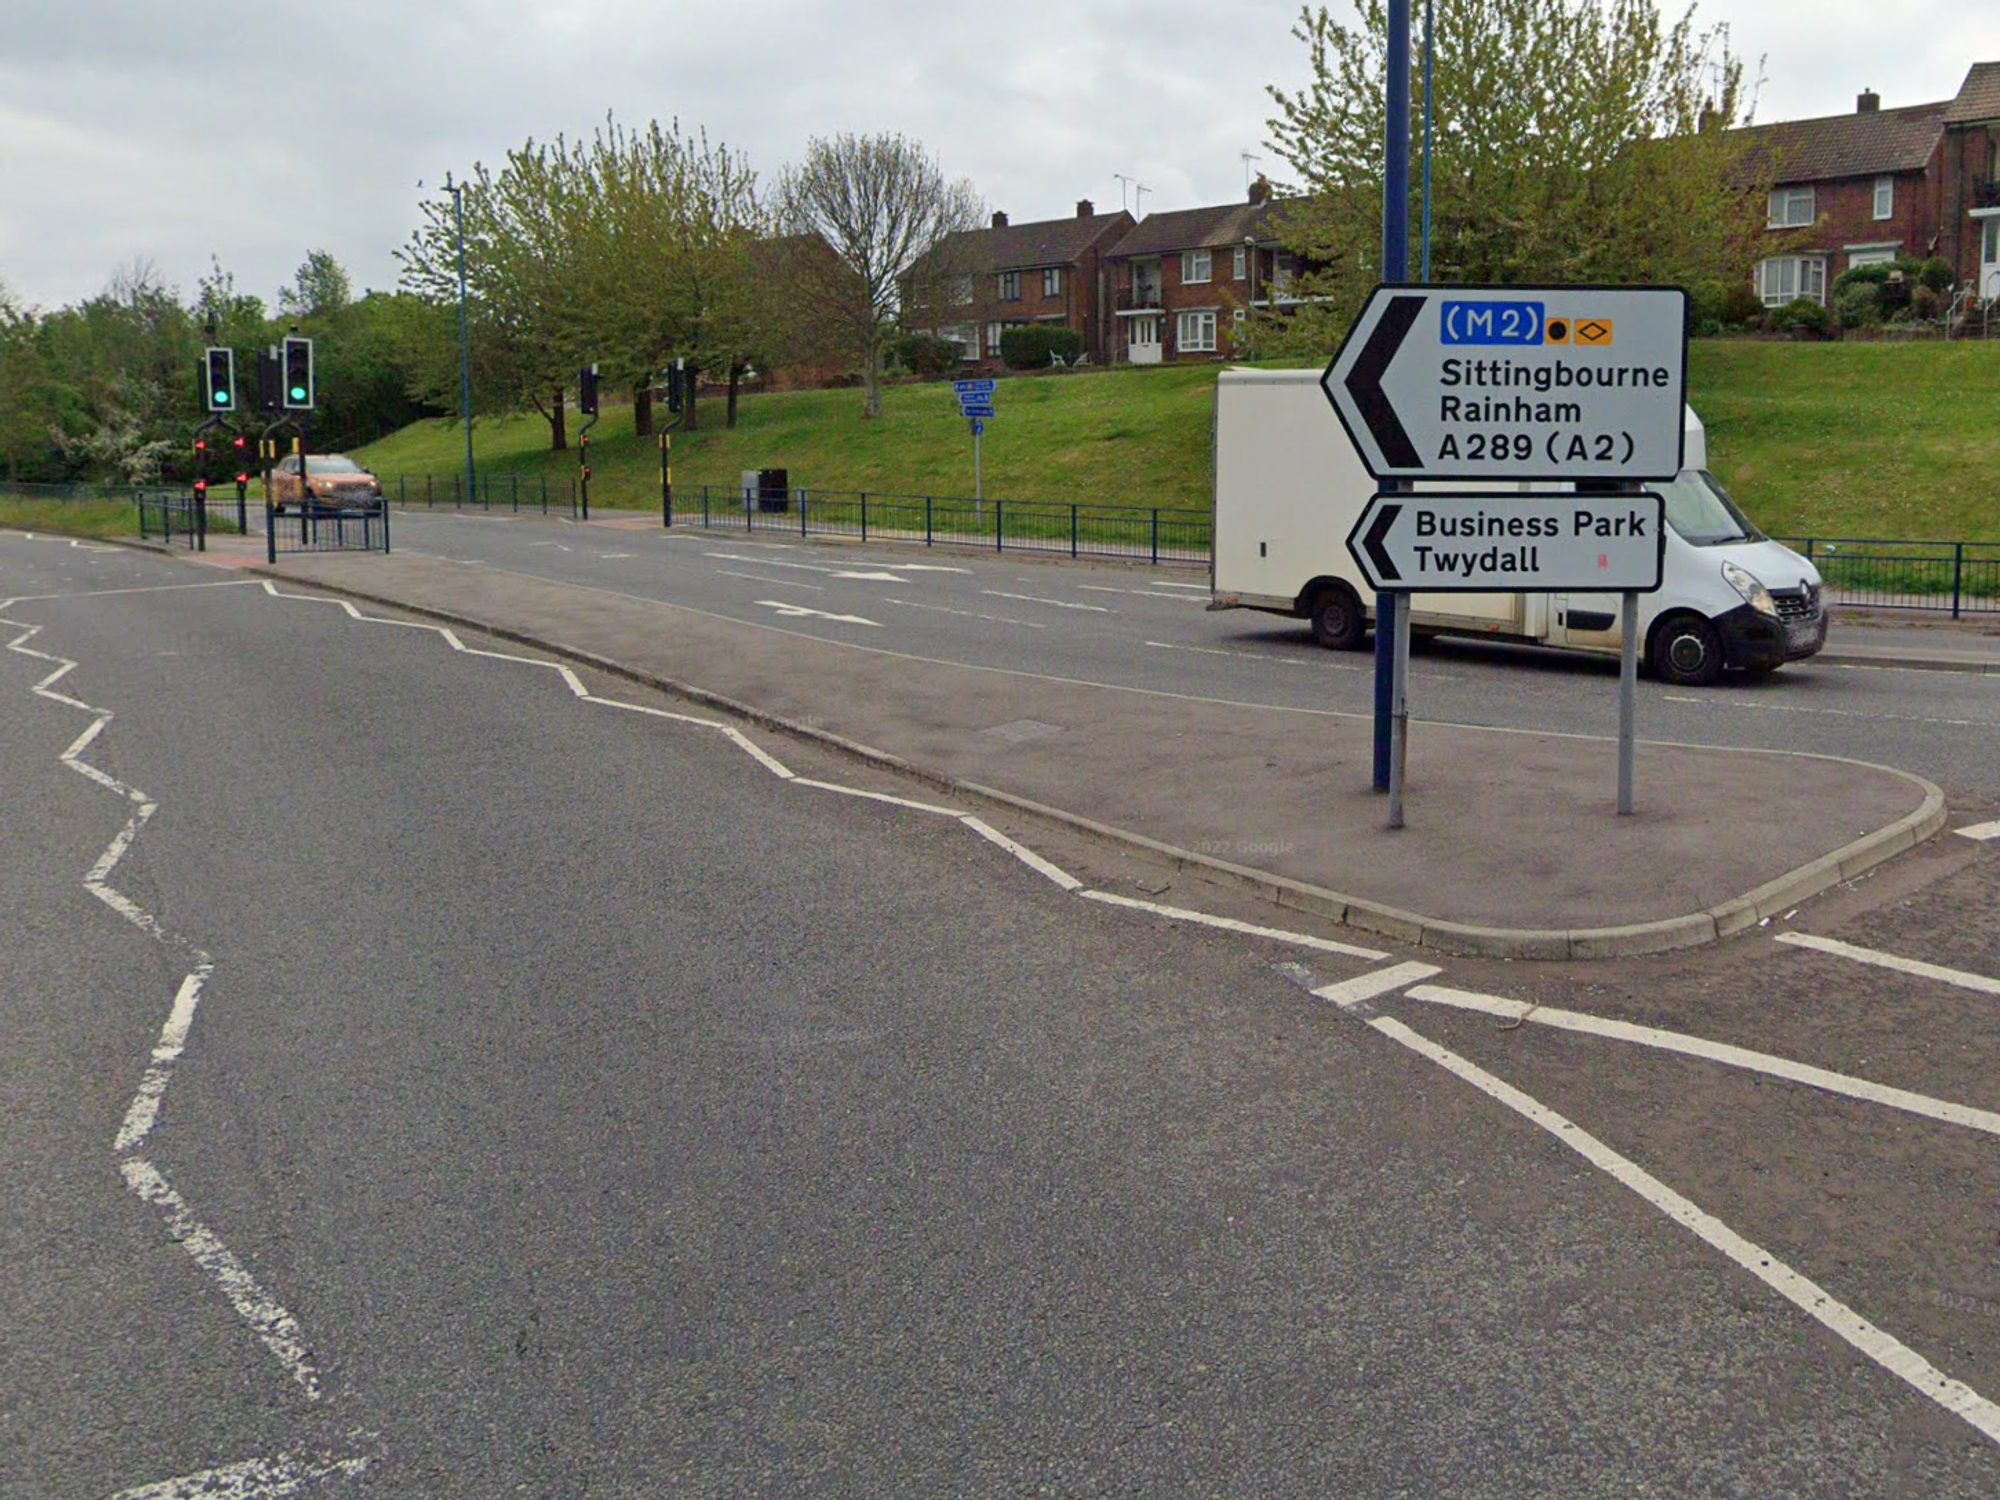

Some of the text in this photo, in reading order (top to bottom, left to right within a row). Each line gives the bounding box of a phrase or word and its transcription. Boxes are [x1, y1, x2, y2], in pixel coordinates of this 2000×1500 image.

[1447, 305, 1539, 340] (M2)
[1440, 359, 1669, 392] Sittingbourne
[1441, 395, 1581, 423] Rainham
[1438, 431, 1635, 465] A289 (A2)
[1416, 511, 1646, 537] Business Park
[1413, 546, 1540, 577] Twydall
